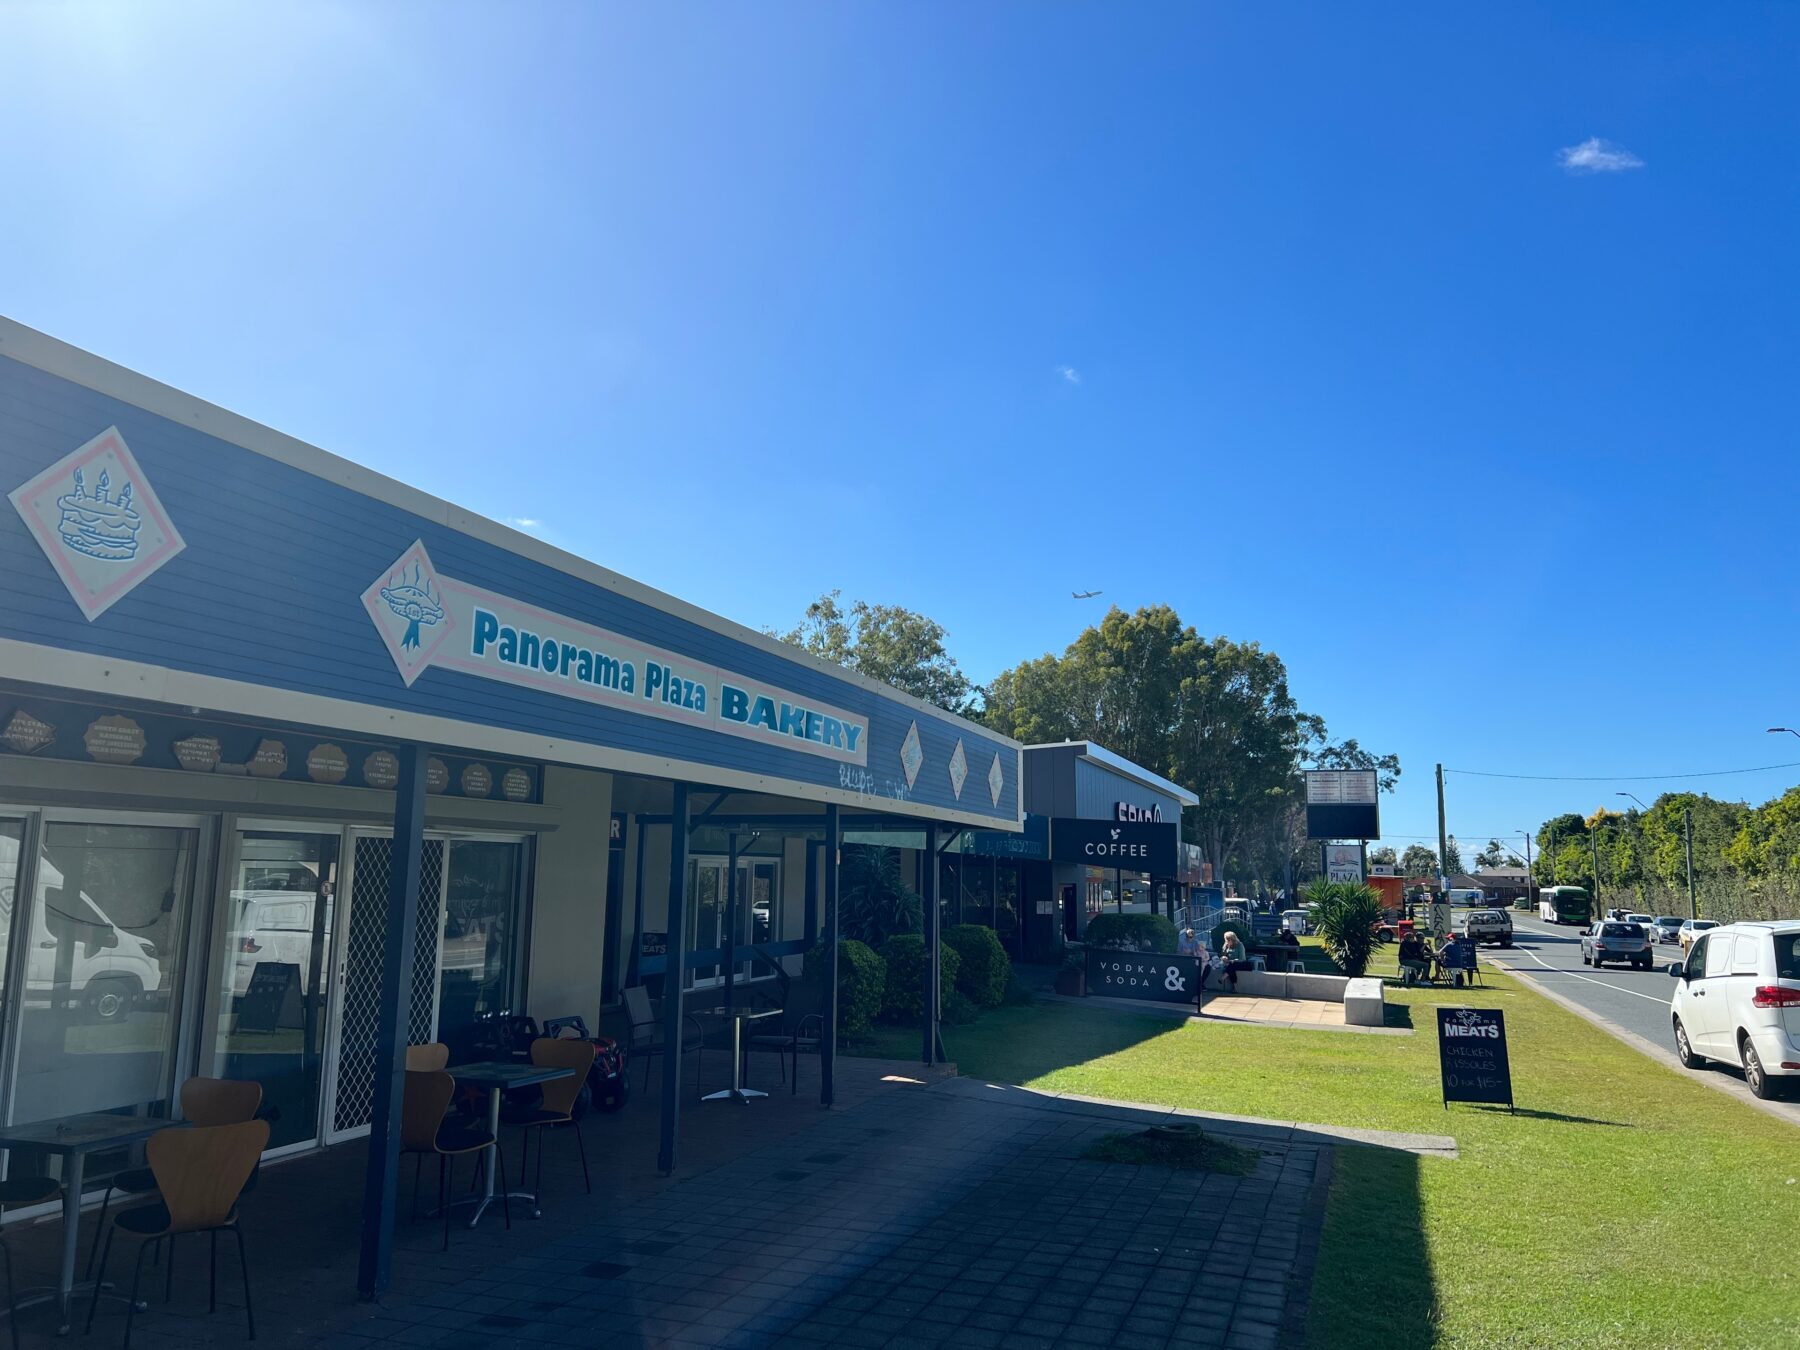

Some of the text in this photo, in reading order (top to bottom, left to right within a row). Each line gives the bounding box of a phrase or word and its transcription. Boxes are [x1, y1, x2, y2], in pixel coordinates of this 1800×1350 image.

[472, 606, 863, 752] Panorama Plaza BAKERY
[1085, 843, 1147, 857] COFFEE
[1330, 872, 1359, 882] PLAZA
[642, 944, 667, 954] EATS
[1100, 962, 1157, 975] VODKA
[1106, 975, 1150, 987] SODA
[1165, 966, 1186, 992] &
[1444, 1023, 1499, 1039] MEATS
[1447, 1046, 1494, 1057] CHICKEN
